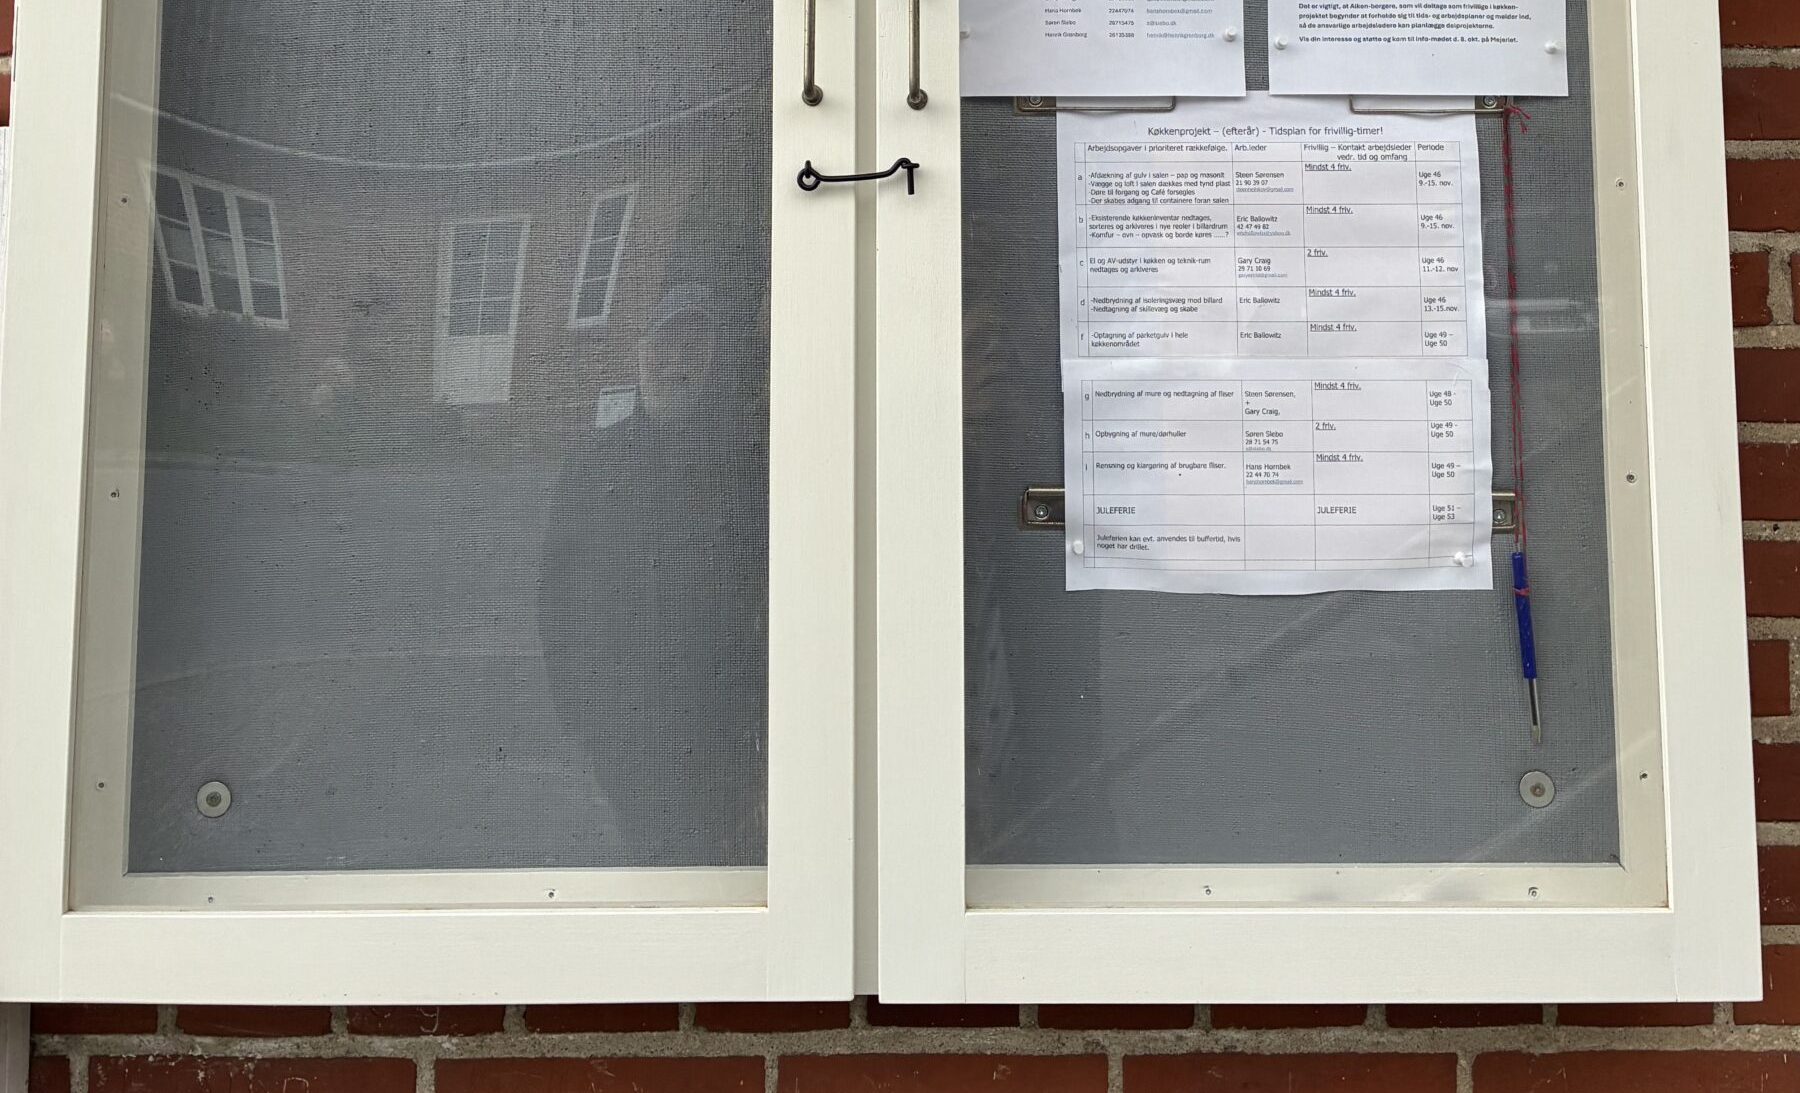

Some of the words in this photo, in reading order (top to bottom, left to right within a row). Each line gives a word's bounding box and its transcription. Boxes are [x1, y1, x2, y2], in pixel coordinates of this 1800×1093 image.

[1147, 127, 1211, 137] Køkkenprojekt
[1221, 125, 1260, 137] (efterår)
[1268, 126, 1306, 136] Tidsplan
[1308, 126, 1322, 135] for
[1324, 126, 1383, 137] frivillig-timer!
[1087, 144, 1142, 153] Arbejdsopgaver
[1148, 144, 1184, 152] prioriteret
[1185, 143, 1228, 152] rækkefølge.
[1303, 143, 1329, 152] Frivillig
[1367, 143, 1412, 152] arbejdsleder
[1416, 142, 1444, 151] Periode
[1357, 153, 1367, 161] tid
[1380, 153, 1408, 162] omfang
[1304, 162, 1329, 172] Mindst
[1337, 162, 1352, 172] friv.
[1133, 171, 1147, 180] gulv
[1418, 171, 1432, 179] Uge
[1313, 248, 1328, 257] friv.
[1237, 257, 1253, 265] Gary
[1253, 256, 1271, 265] Craig
[1314, 382, 1338, 390] Mindst
[1346, 381, 1362, 390] friv.
[1094, 390, 1135, 398] Nedbrydning
[1172, 390, 1209, 398] nedtagning
[1244, 407, 1260, 416] Gary
[1261, 407, 1280, 416] Craig,
[1094, 429, 1130, 438] Opbygning
[1430, 430, 1444, 439] Uge
[1095, 506, 1135, 514] JULEFERIE
[1316, 506, 1356, 514] JULEFERIE
[1432, 504, 1446, 513] Uge
